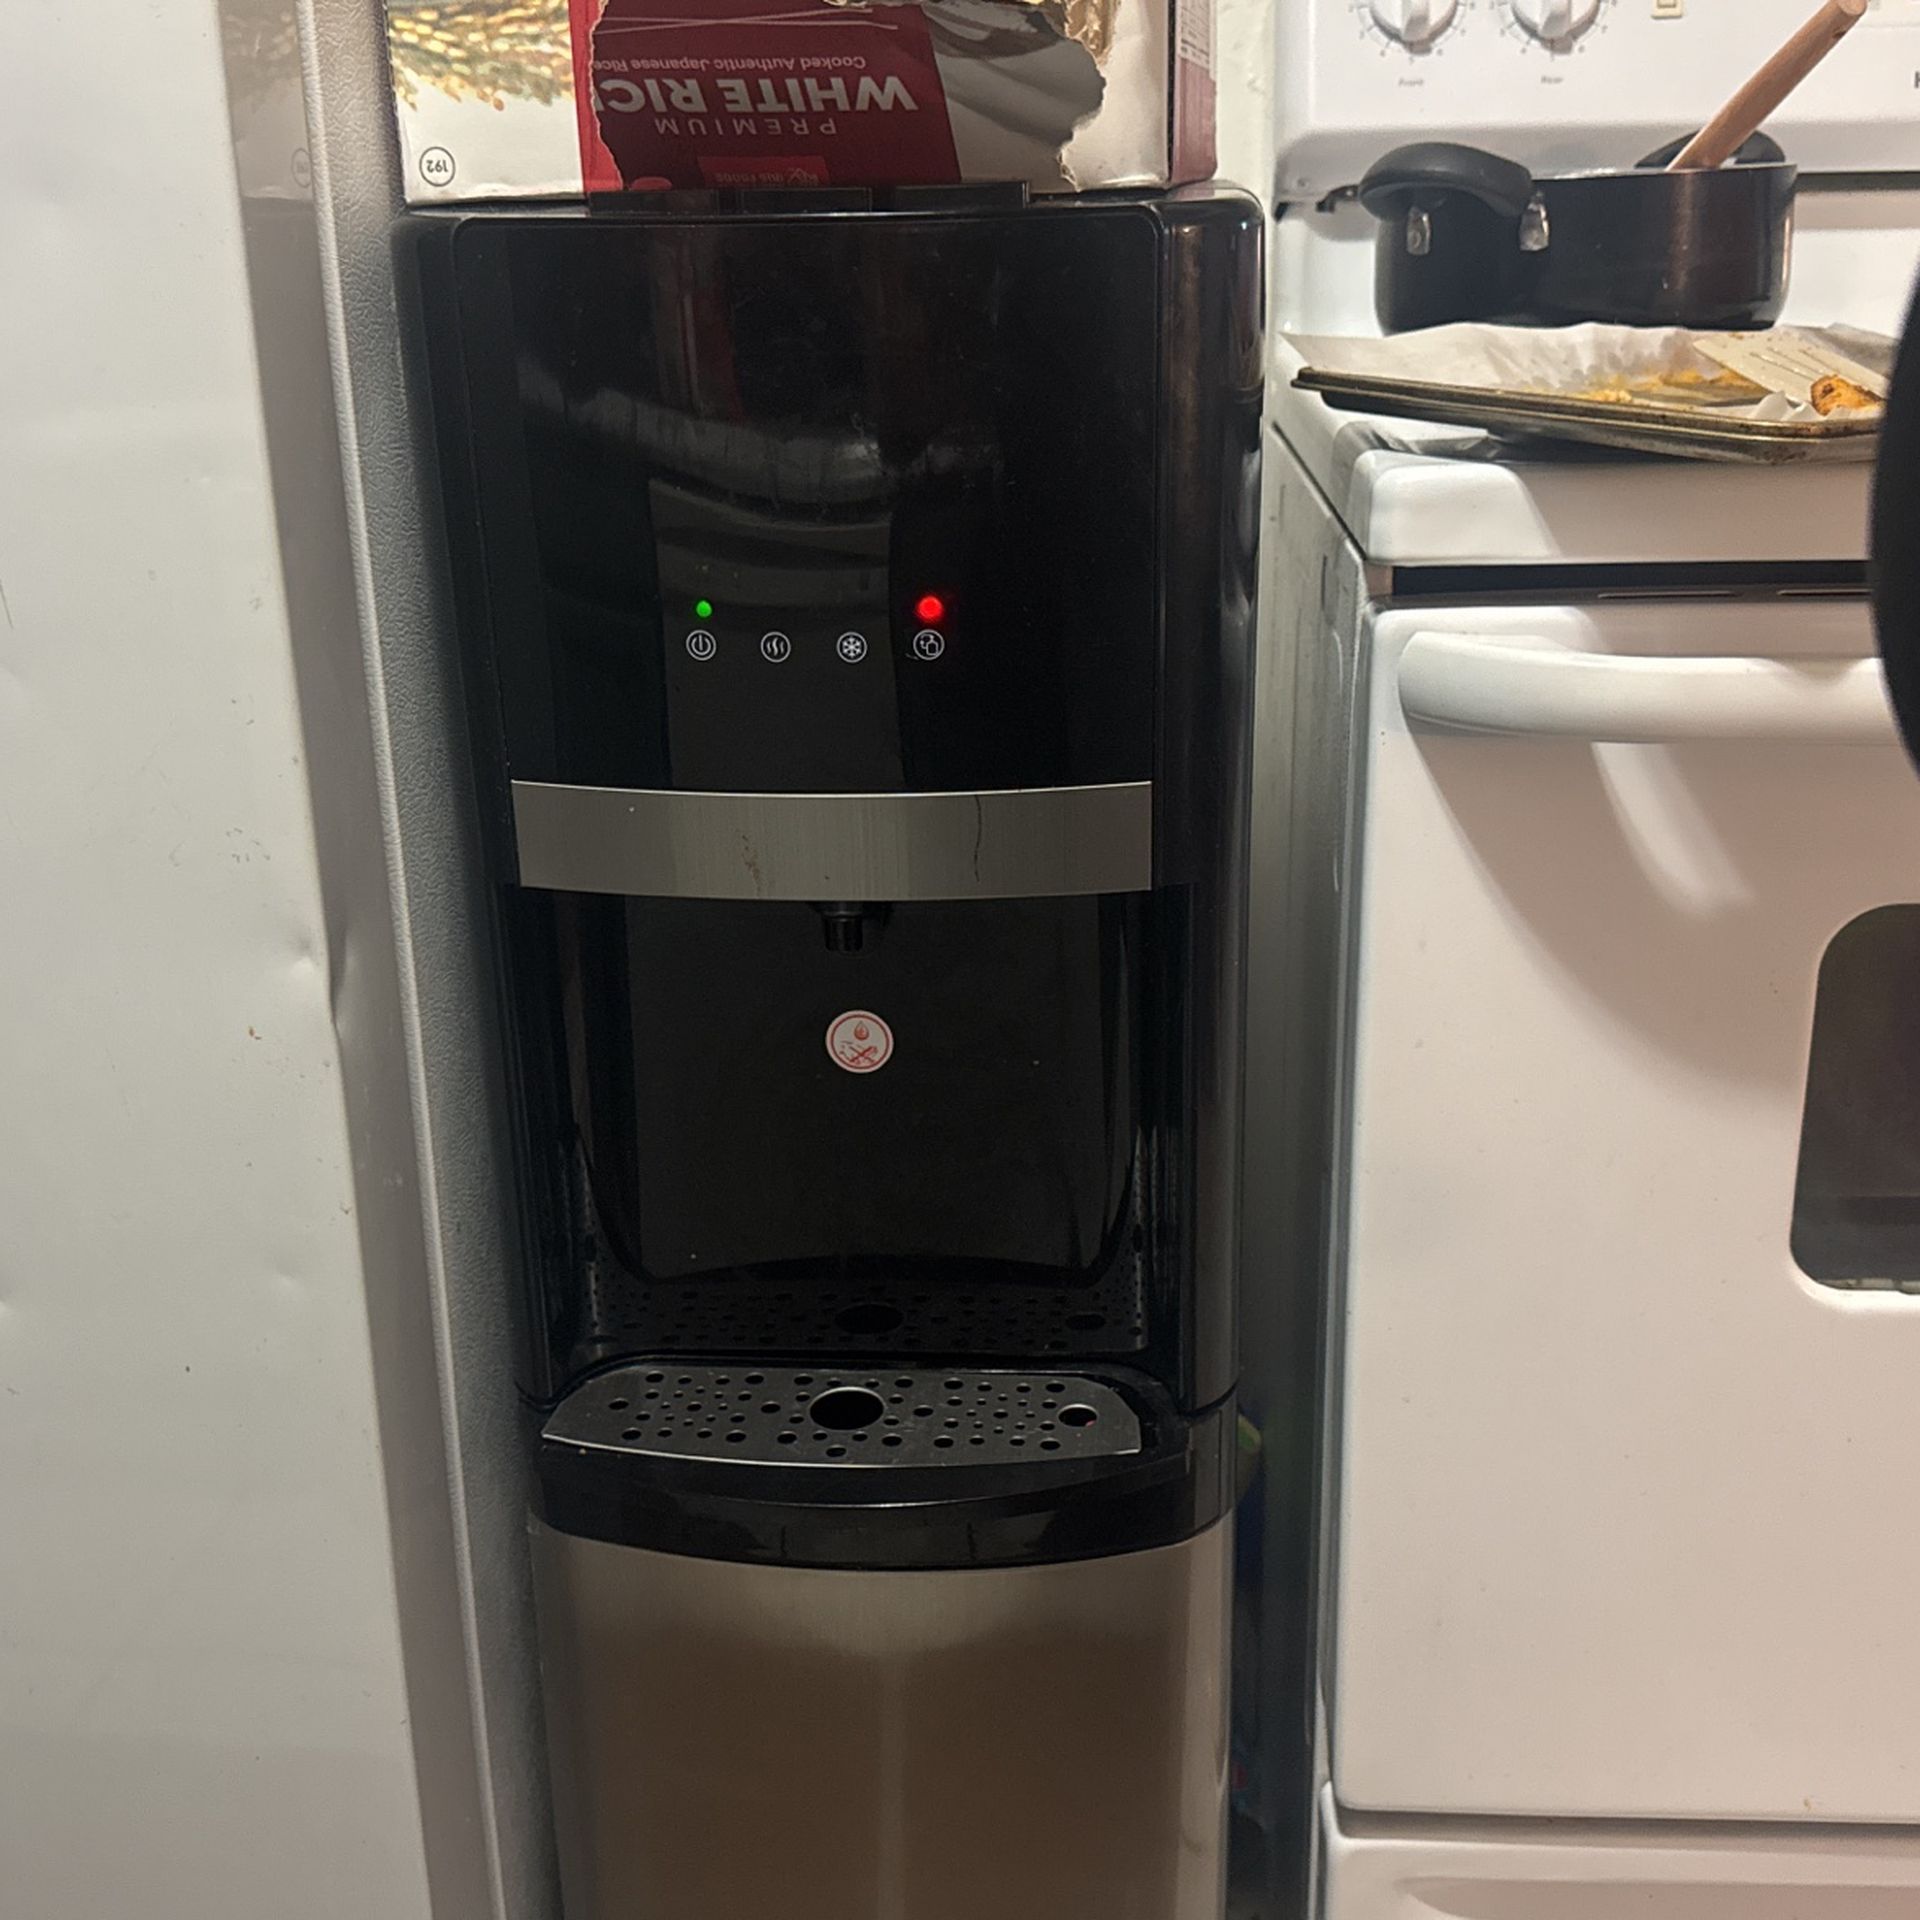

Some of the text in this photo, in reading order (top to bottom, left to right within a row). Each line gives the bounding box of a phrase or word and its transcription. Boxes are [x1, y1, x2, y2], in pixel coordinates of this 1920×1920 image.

[631, 57, 709, 71] Japanese
[715, 57, 795, 70] Authentic
[800, 56, 866, 71] Cooked
[715, 76, 918, 112] WHITE
[654, 117, 837, 136] PREMIUM
[426, 159, 449, 173] 192
